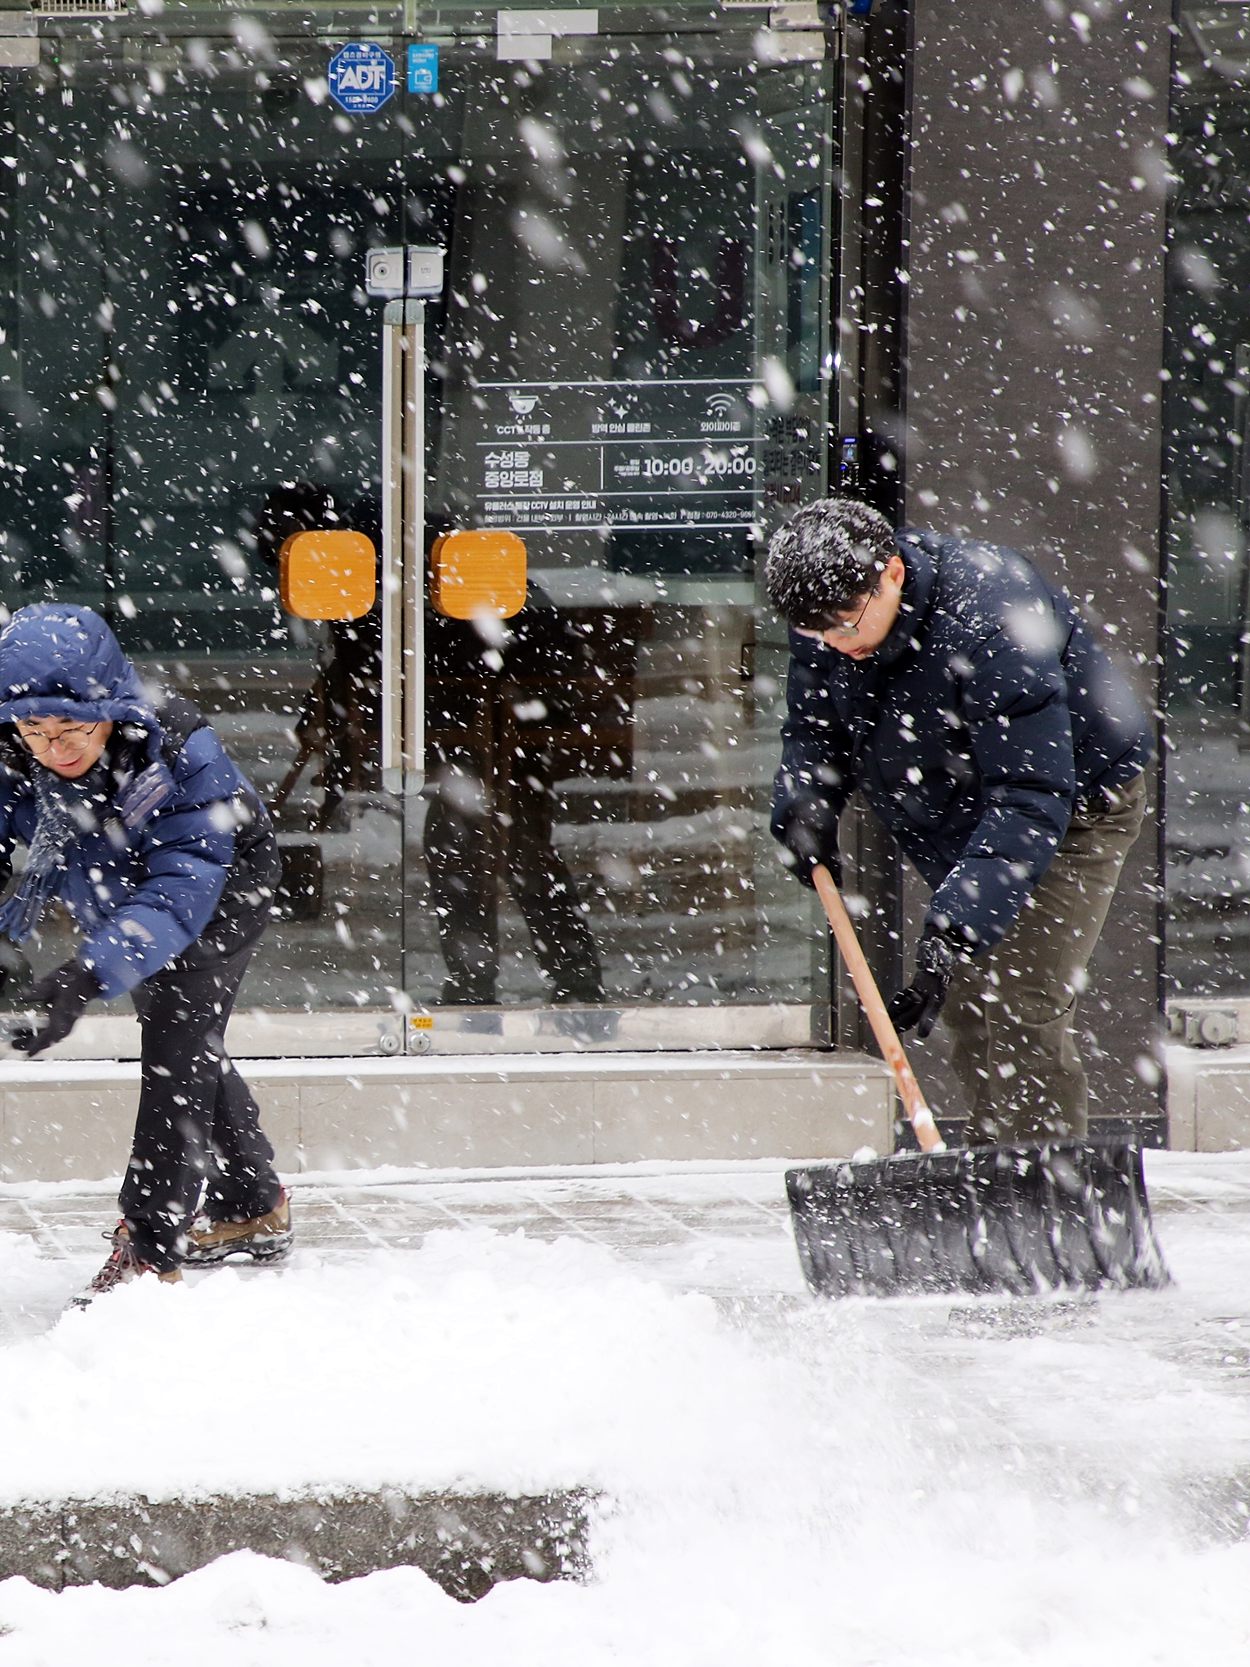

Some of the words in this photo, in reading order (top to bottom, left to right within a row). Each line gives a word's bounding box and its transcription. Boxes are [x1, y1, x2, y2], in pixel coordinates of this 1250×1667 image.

[339, 65, 385, 91] ADT
[609, 423, 626, 433] 안심
[484, 450, 529, 469] 수성동
[643, 458, 694, 476] 10:00
[704, 457, 757, 475] 20:00
[484, 470, 544, 488] 중앙로점
[531, 500, 549, 511] CCTV
[581, 499, 597, 509] 안내
